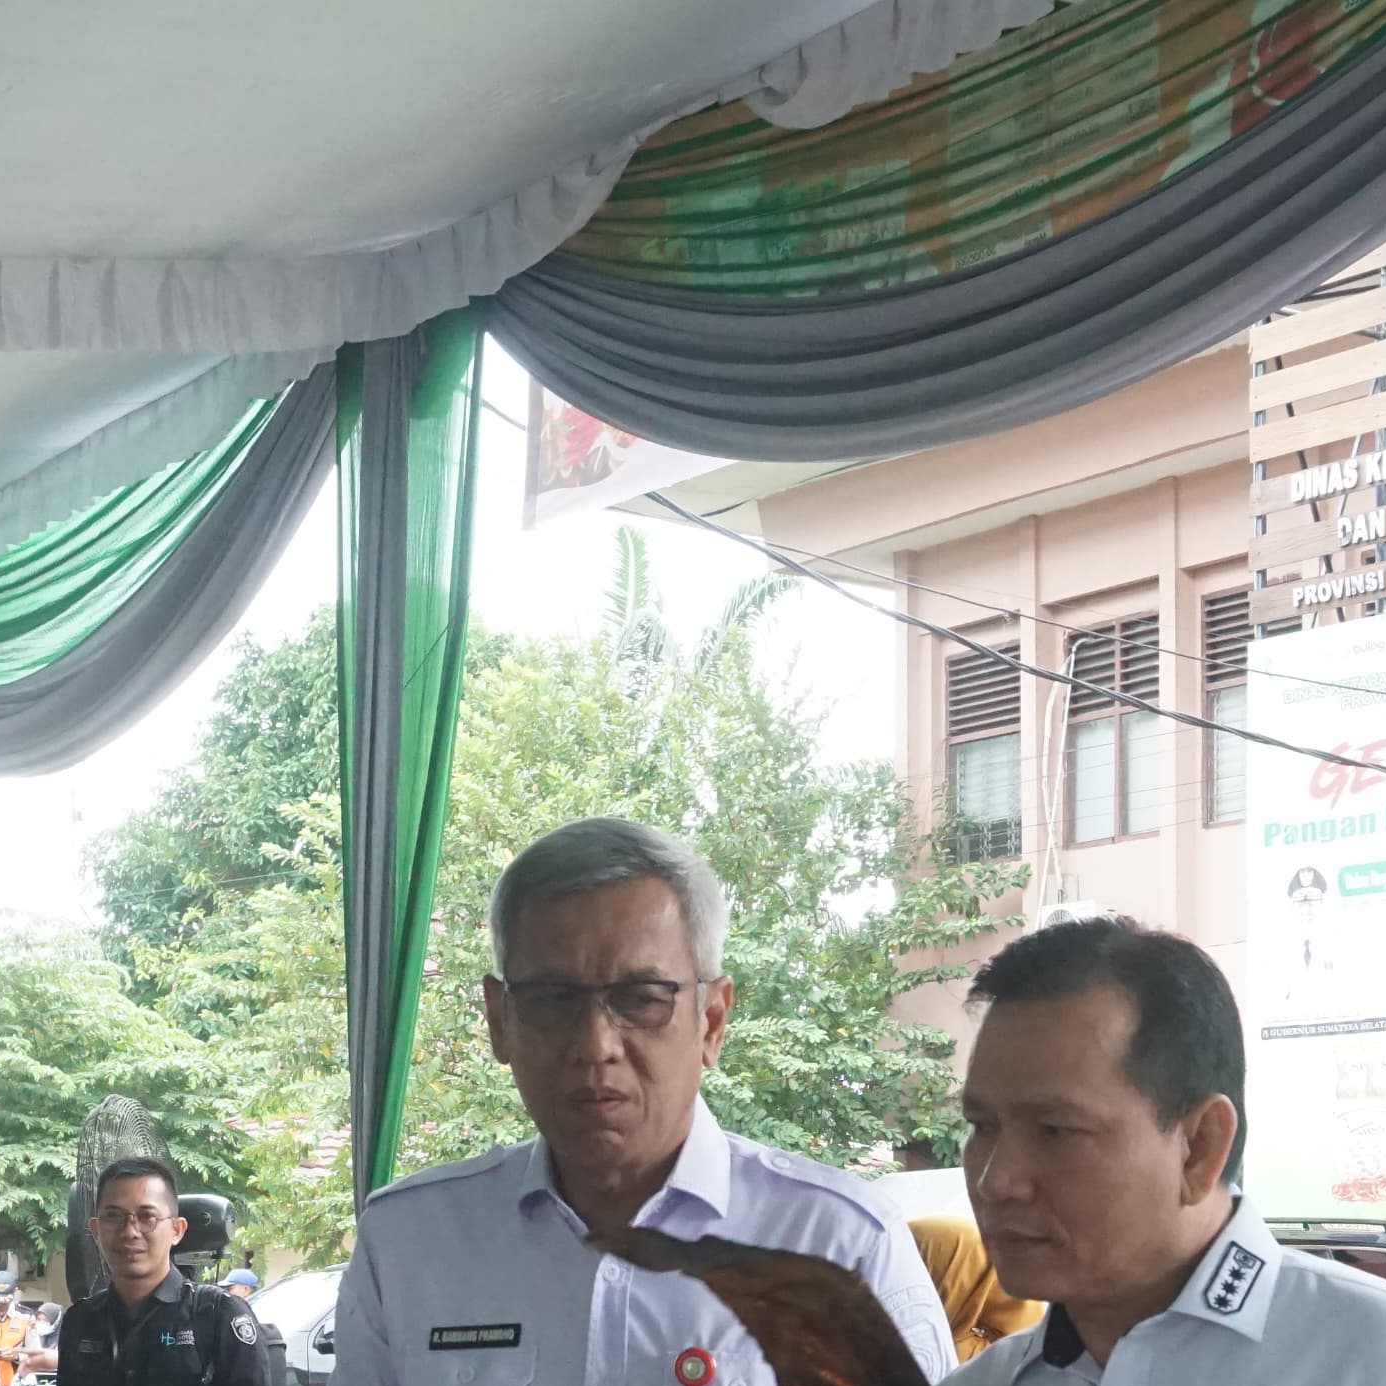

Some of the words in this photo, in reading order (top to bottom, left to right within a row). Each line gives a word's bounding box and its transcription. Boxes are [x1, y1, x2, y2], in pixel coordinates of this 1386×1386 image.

[1290, 457, 1359, 502] DINAS
[1336, 508, 1386, 547] DAN
[1292, 570, 1385, 607] PROVINSI
[1283, 684, 1328, 704] DINAS
[1264, 809, 1377, 848] Pangan
[1269, 1026, 1316, 1037] GUBERNUR
[1317, 1023, 1359, 1034] SUMATERA
